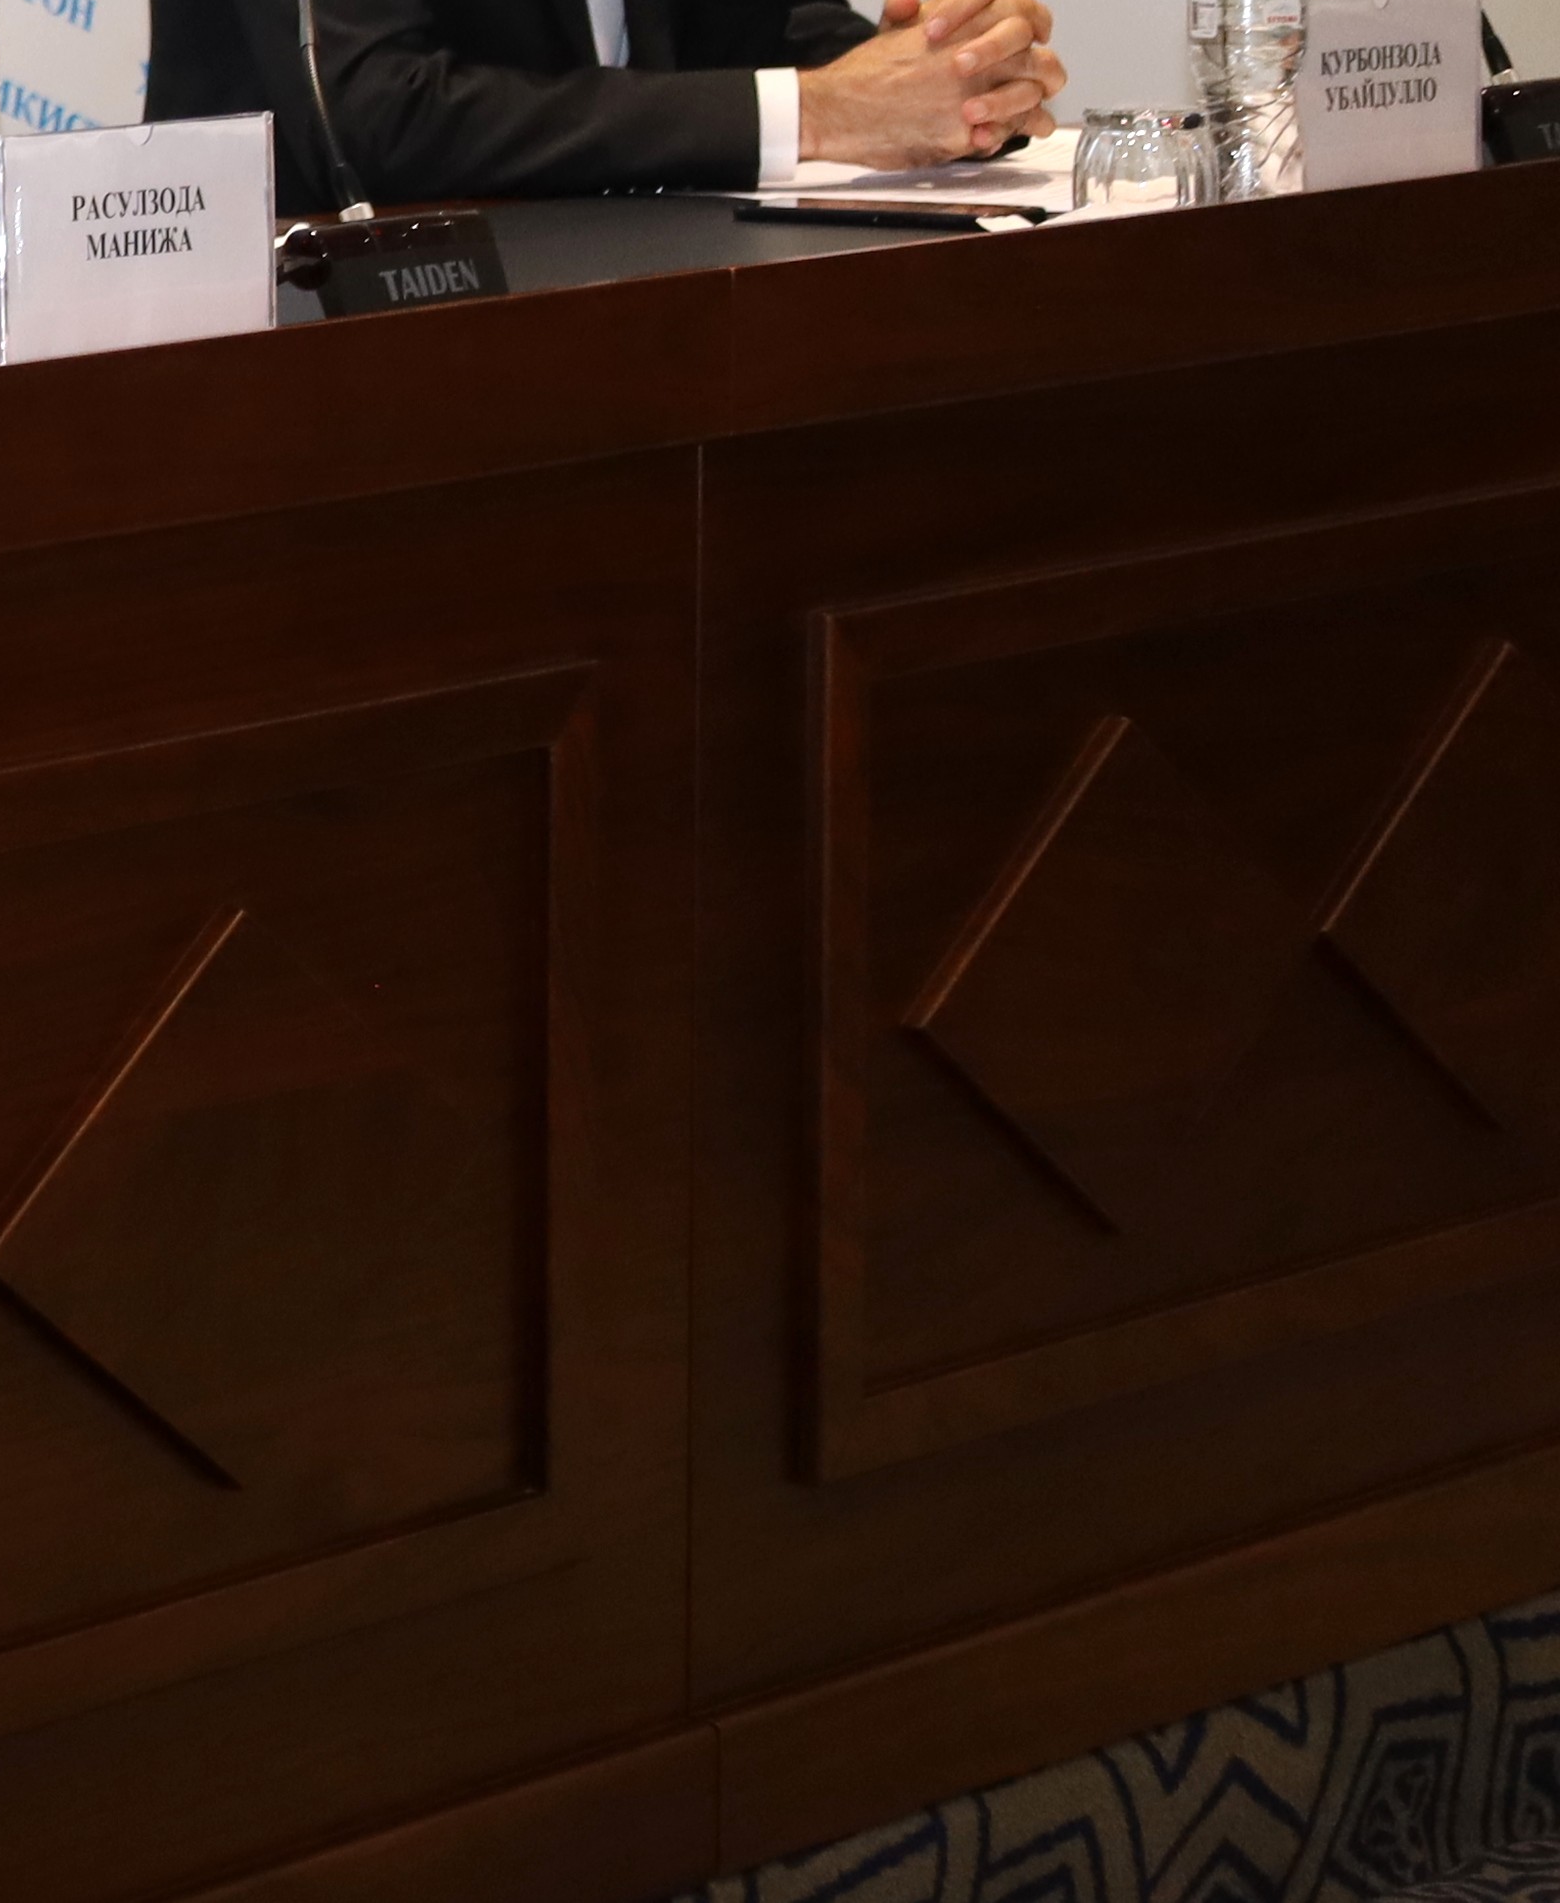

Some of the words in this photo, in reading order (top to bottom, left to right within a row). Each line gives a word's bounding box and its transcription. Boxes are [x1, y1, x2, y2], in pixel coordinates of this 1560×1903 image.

[1324, 77, 1438, 113] УБАЙДУЛЛО
[72, 185, 206, 222] РАСУЛЗОДА
[86, 227, 193, 261] МАНИЖА
[378, 258, 480, 302] TAIDEN
